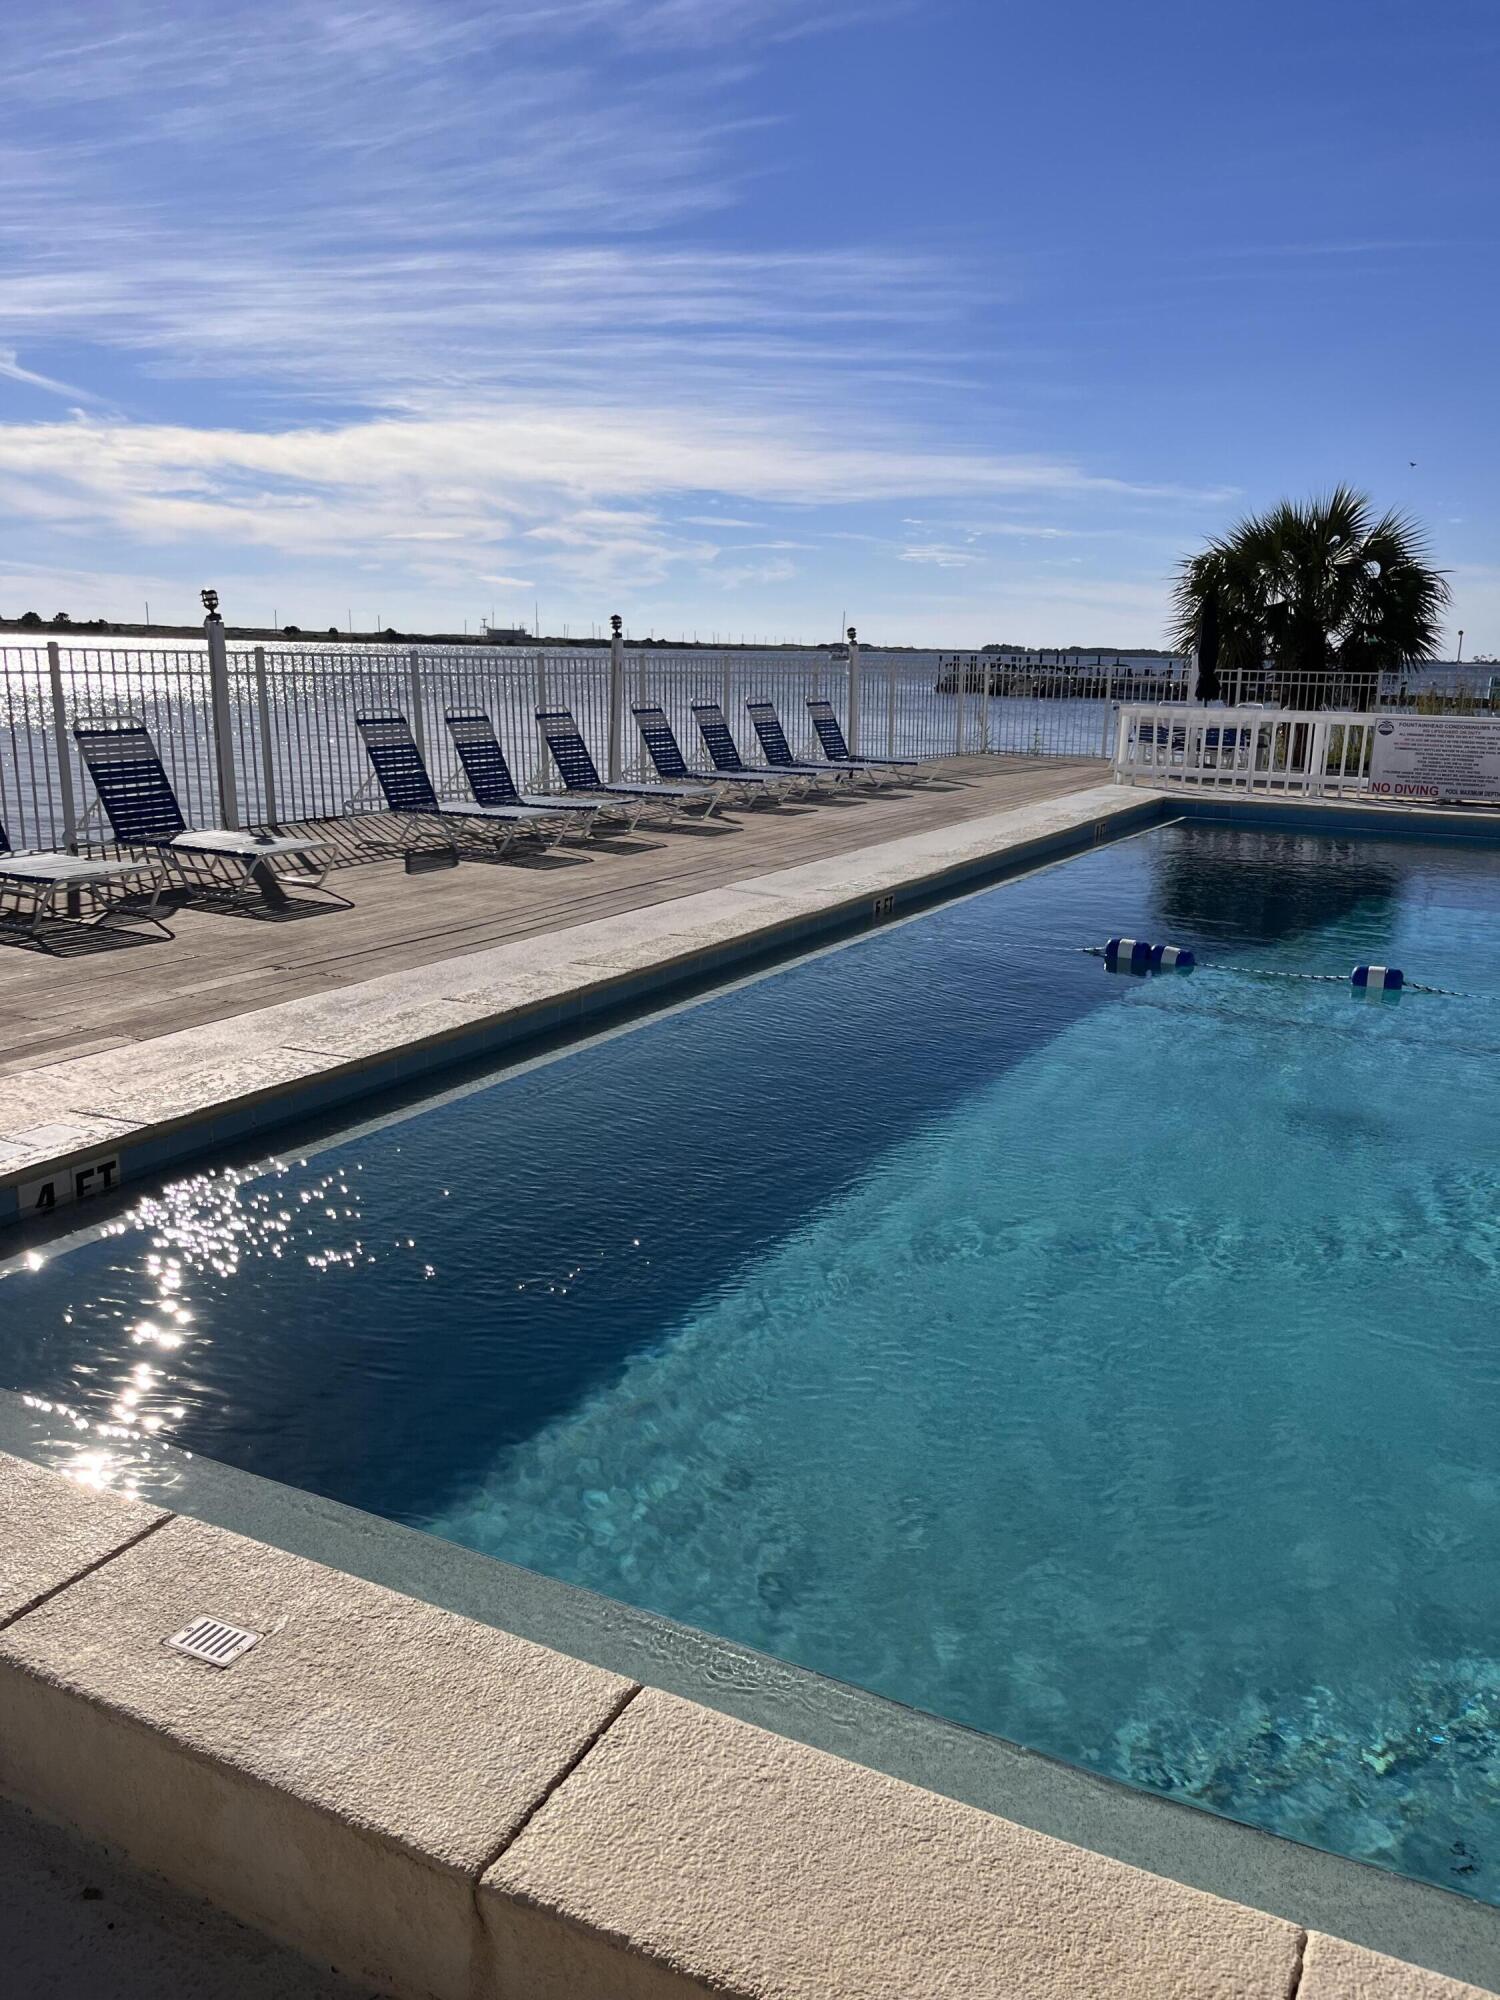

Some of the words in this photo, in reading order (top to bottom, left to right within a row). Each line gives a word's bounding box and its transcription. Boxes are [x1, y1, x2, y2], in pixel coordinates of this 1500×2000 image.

[1372, 782, 1391, 793] NO
[1395, 783, 1439, 796] DIVING
[35, 1182, 56, 1211] 4
[76, 1160, 117, 1197] FT
